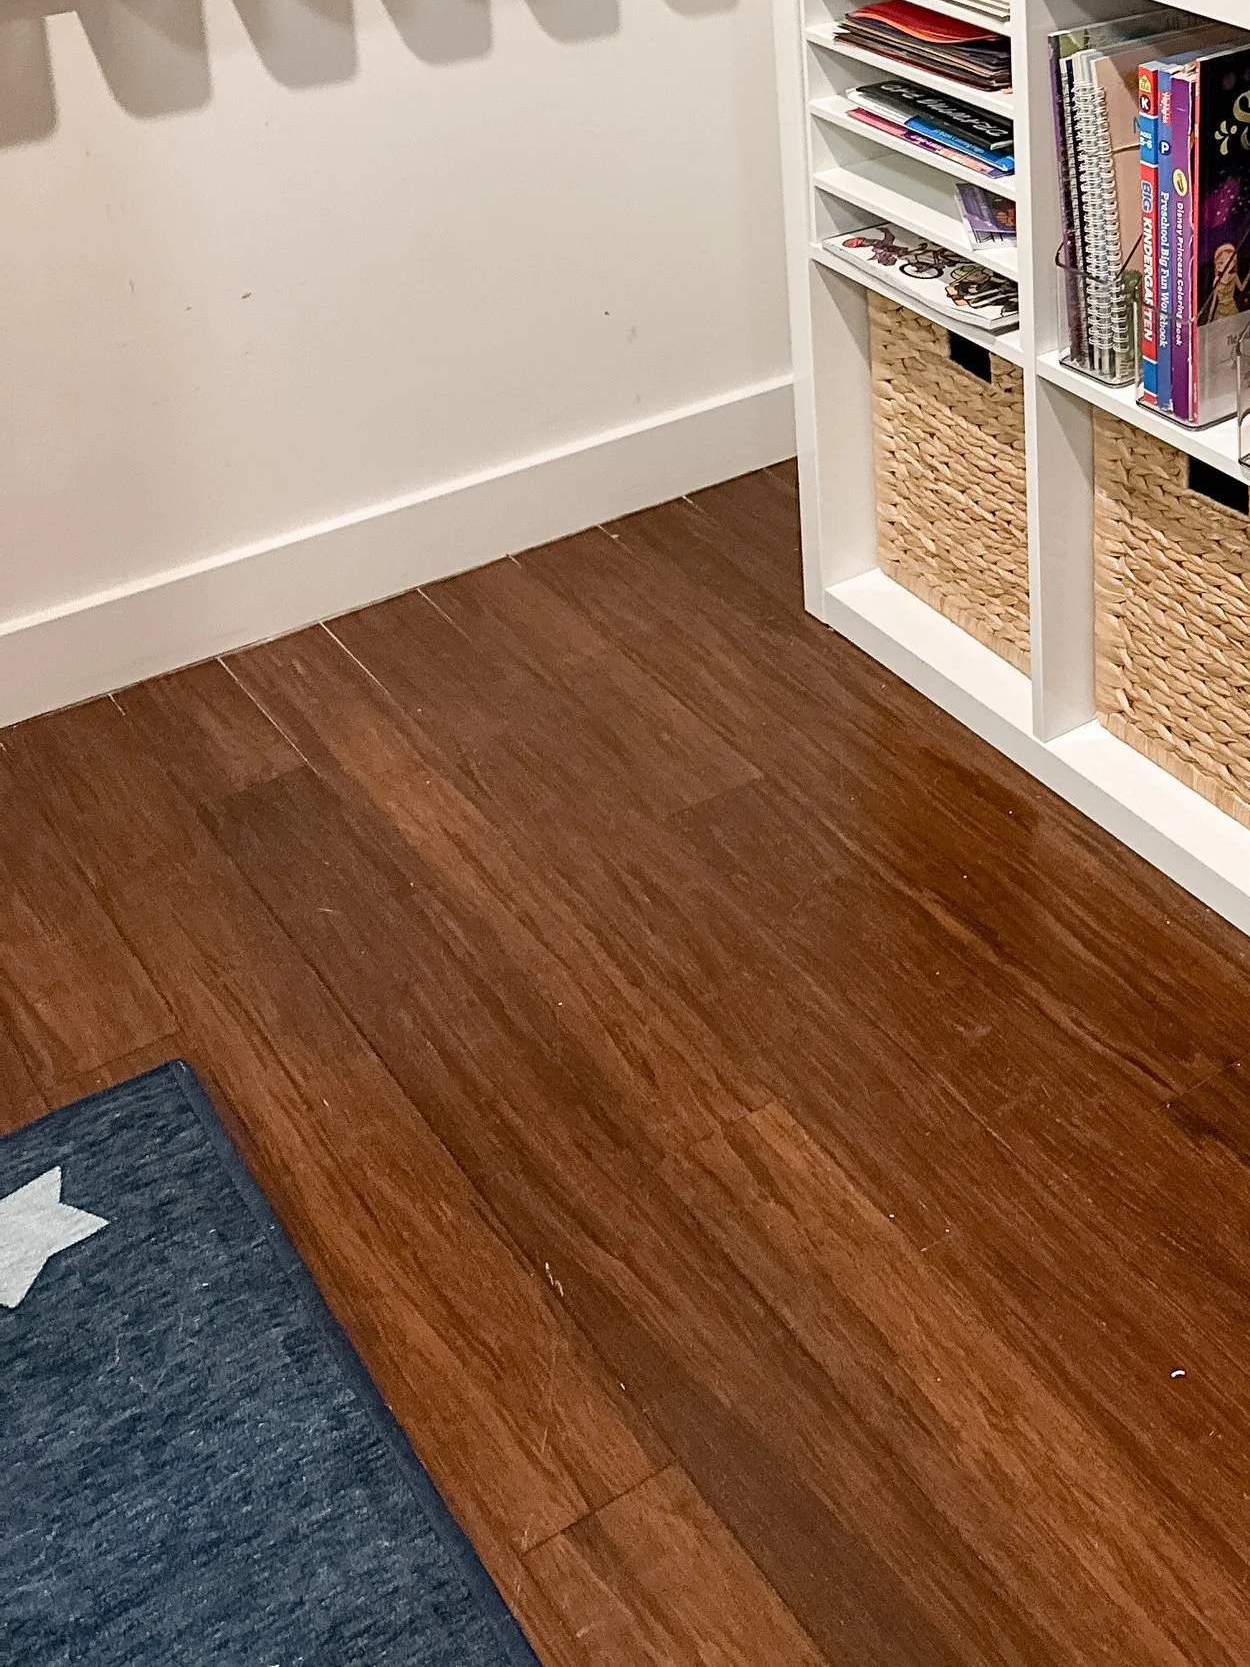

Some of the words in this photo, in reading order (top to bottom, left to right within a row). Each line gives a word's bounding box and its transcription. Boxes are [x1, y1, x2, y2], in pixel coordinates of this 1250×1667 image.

[1141, 97, 1149, 110] K
[1161, 141, 1170, 154] P
[1141, 180, 1152, 213] BIG
[1159, 191, 1170, 246] Preschool
[1174, 202, 1185, 237] Disney
[1158, 248, 1170, 265] Big
[1174, 237, 1184, 278] Princess
[1159, 267, 1170, 290] Fun
[1175, 279, 1184, 320] Coloring
